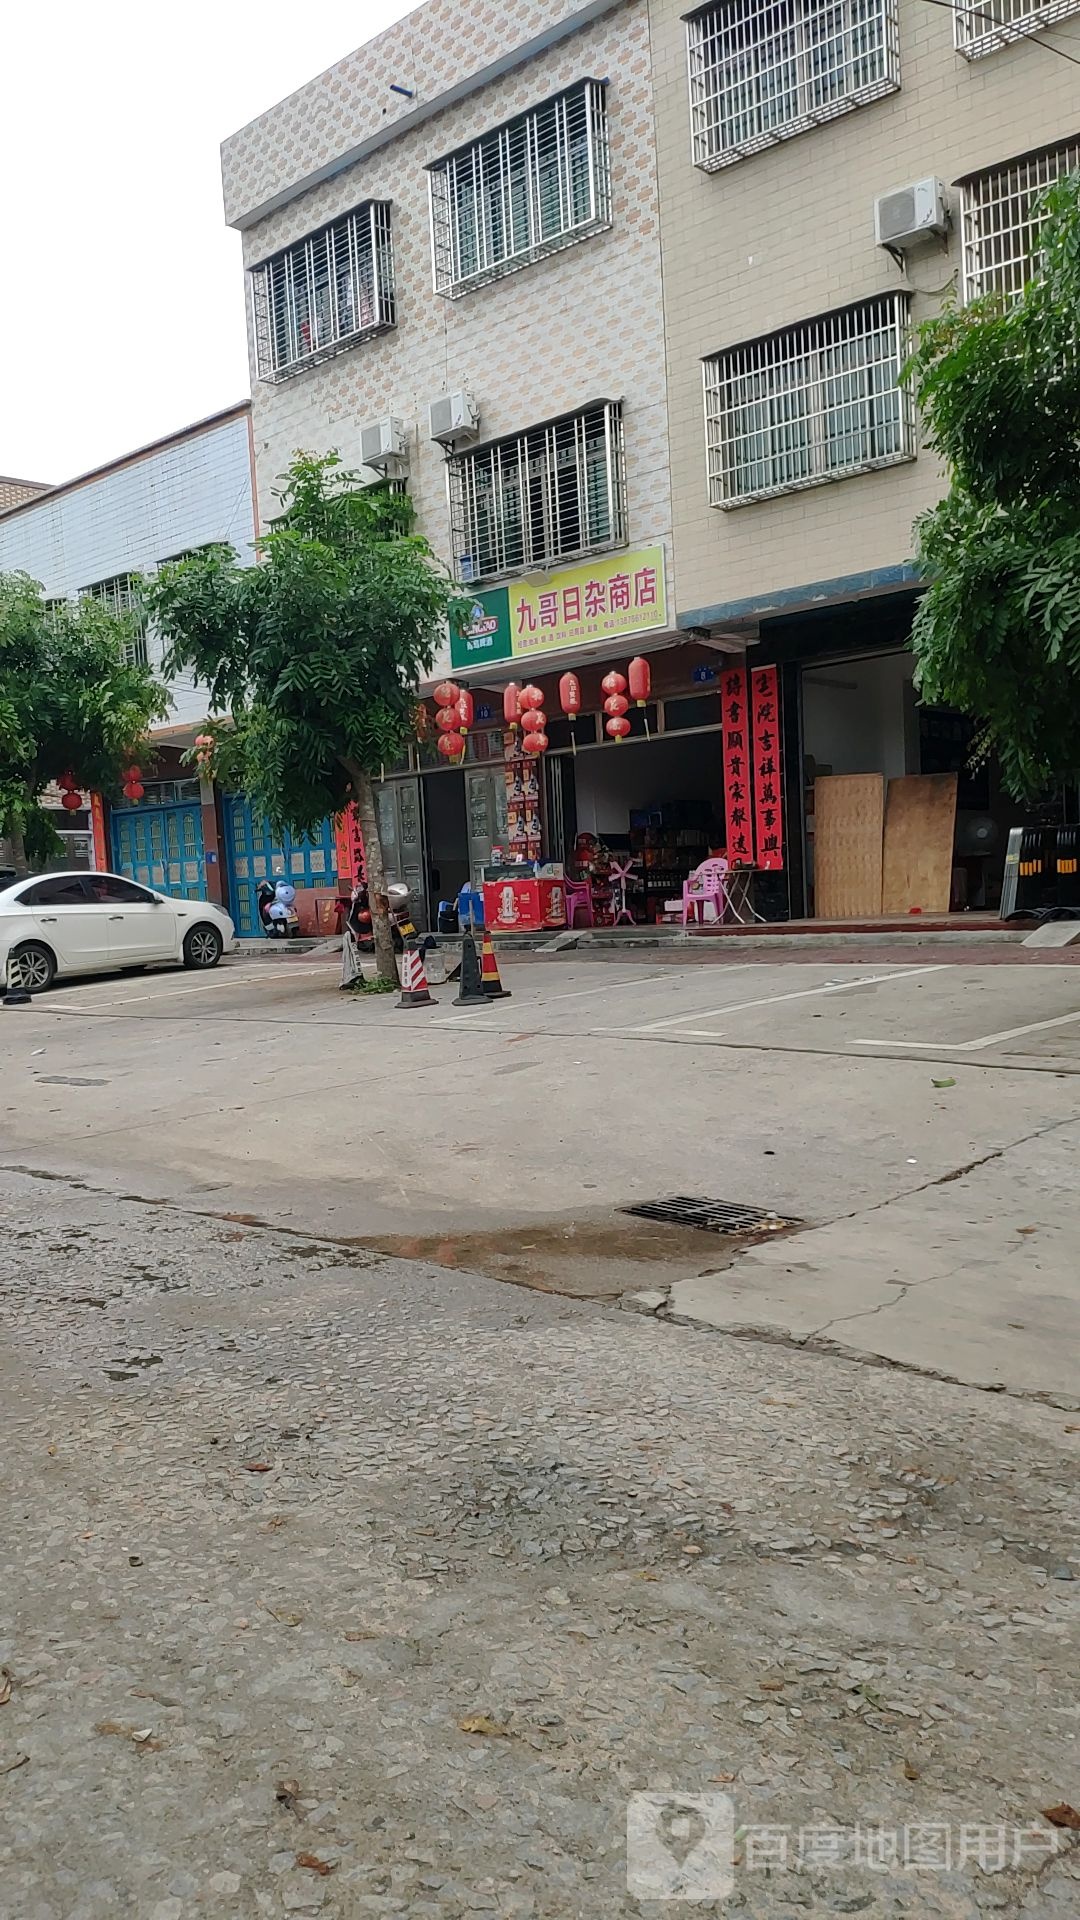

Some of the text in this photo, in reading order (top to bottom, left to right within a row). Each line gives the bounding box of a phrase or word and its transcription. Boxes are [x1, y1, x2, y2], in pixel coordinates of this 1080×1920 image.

[516, 567, 657, 633] 九哥日杂商店
